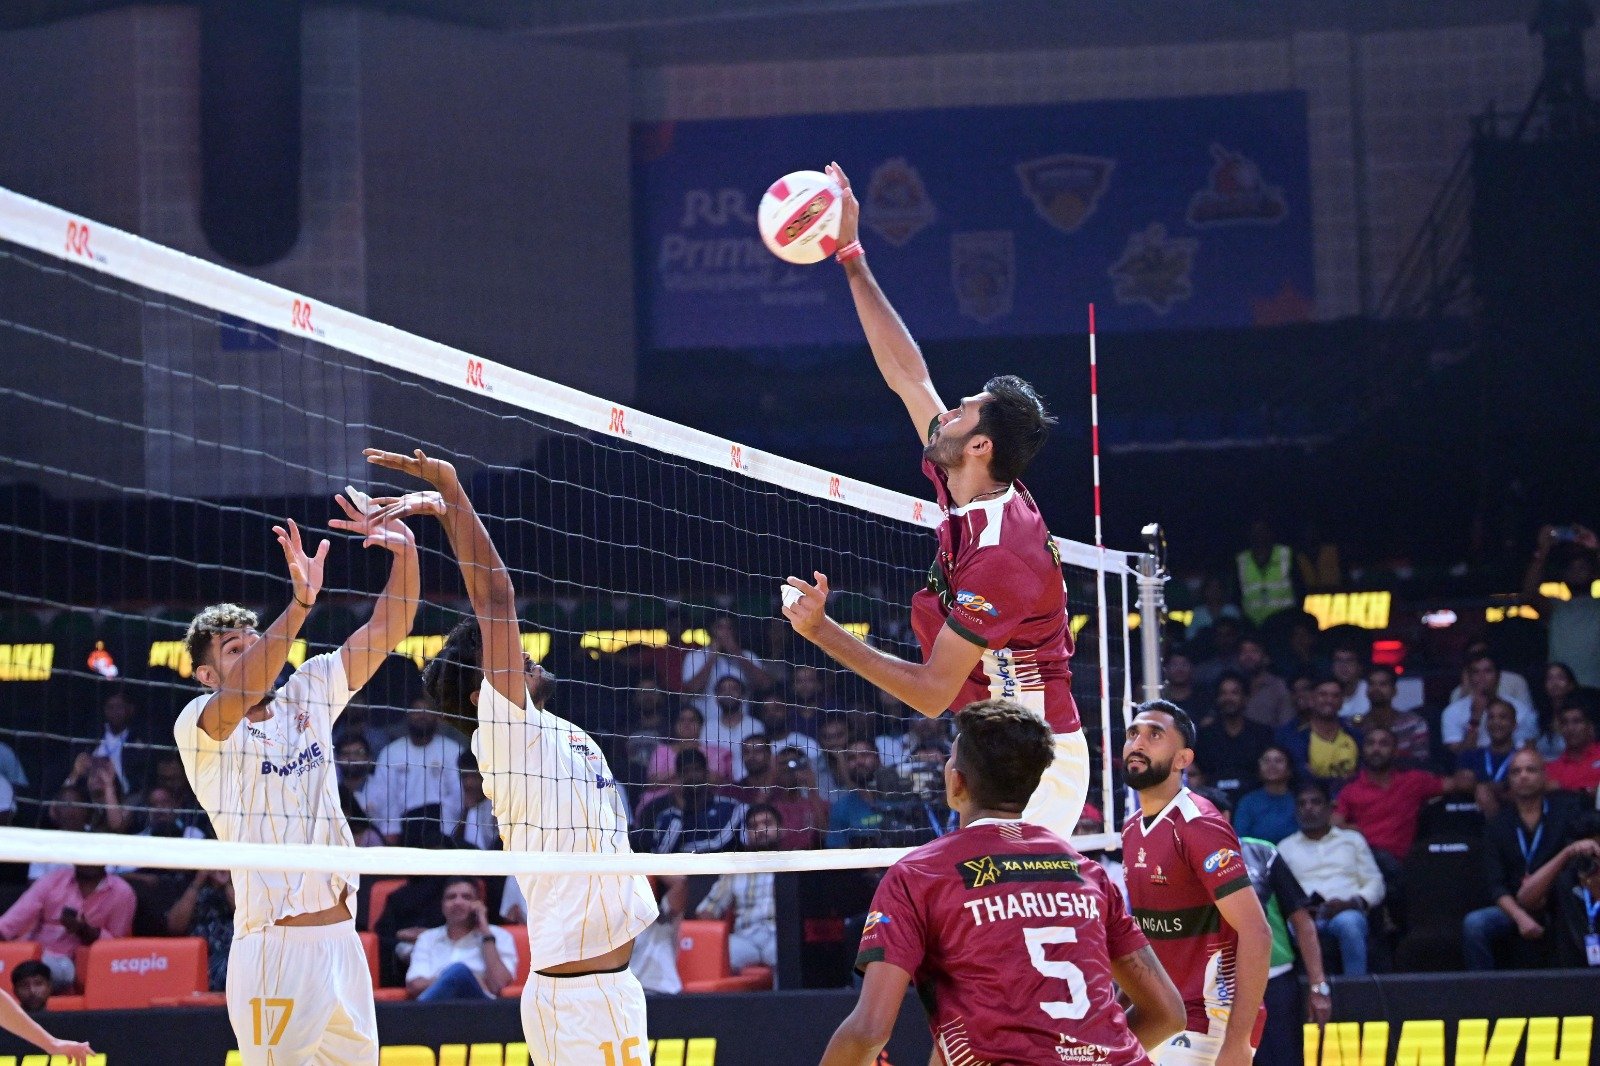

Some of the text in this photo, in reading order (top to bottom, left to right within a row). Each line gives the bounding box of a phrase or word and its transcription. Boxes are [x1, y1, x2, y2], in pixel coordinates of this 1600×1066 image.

[956, 606, 983, 625] BISCUITS
[1002, 861, 1021, 871] XA
[963, 892, 1100, 926] THARUSHA
[110, 953, 168, 975] scapia
[1023, 926, 1091, 1020] 5
[249, 997, 294, 1046] 17
[598, 1036, 643, 1066] 16
[1055, 1045, 1096, 1056] Prime
[1060, 1054, 1095, 1063] Volleyball
